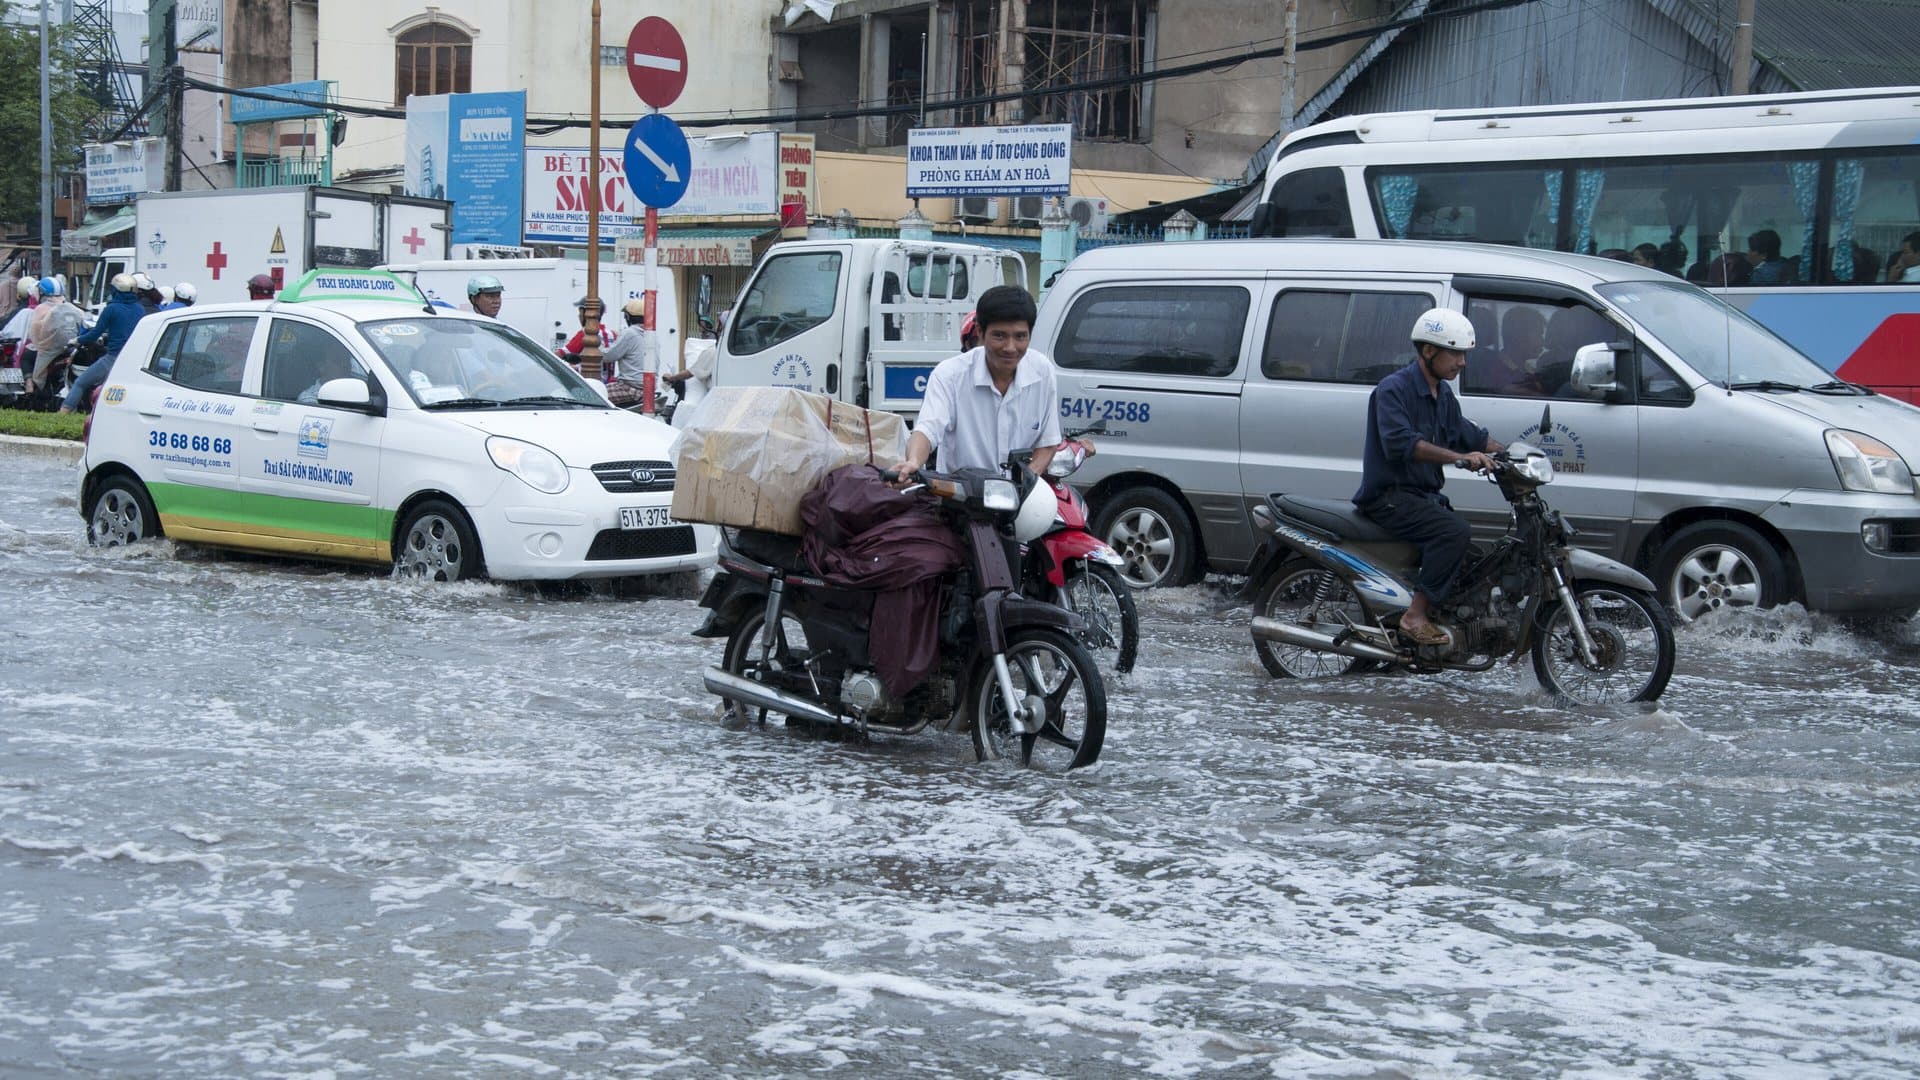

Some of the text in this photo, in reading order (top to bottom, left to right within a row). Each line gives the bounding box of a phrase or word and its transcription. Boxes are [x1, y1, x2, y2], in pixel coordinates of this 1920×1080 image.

[910, 145, 932, 161] KHOA
[934, 144, 958, 161] THAM
[544, 153, 626, 174] BÊ TÔN
[1004, 168, 1021, 181] AN
[316, 278, 336, 289] TAXI
[371, 279, 395, 290] LONG
[164, 397, 181, 410] Taxi
[1060, 397, 1151, 423] 54Y-2588
[149, 430, 232, 455] 38 68 68 68
[264, 459, 278, 475] Taxi
[334, 469, 354, 487] LONG
[635, 471, 652, 480] KIA
[621, 508, 677, 528] 51A-379.
[801, 576, 825, 587] HONDA
